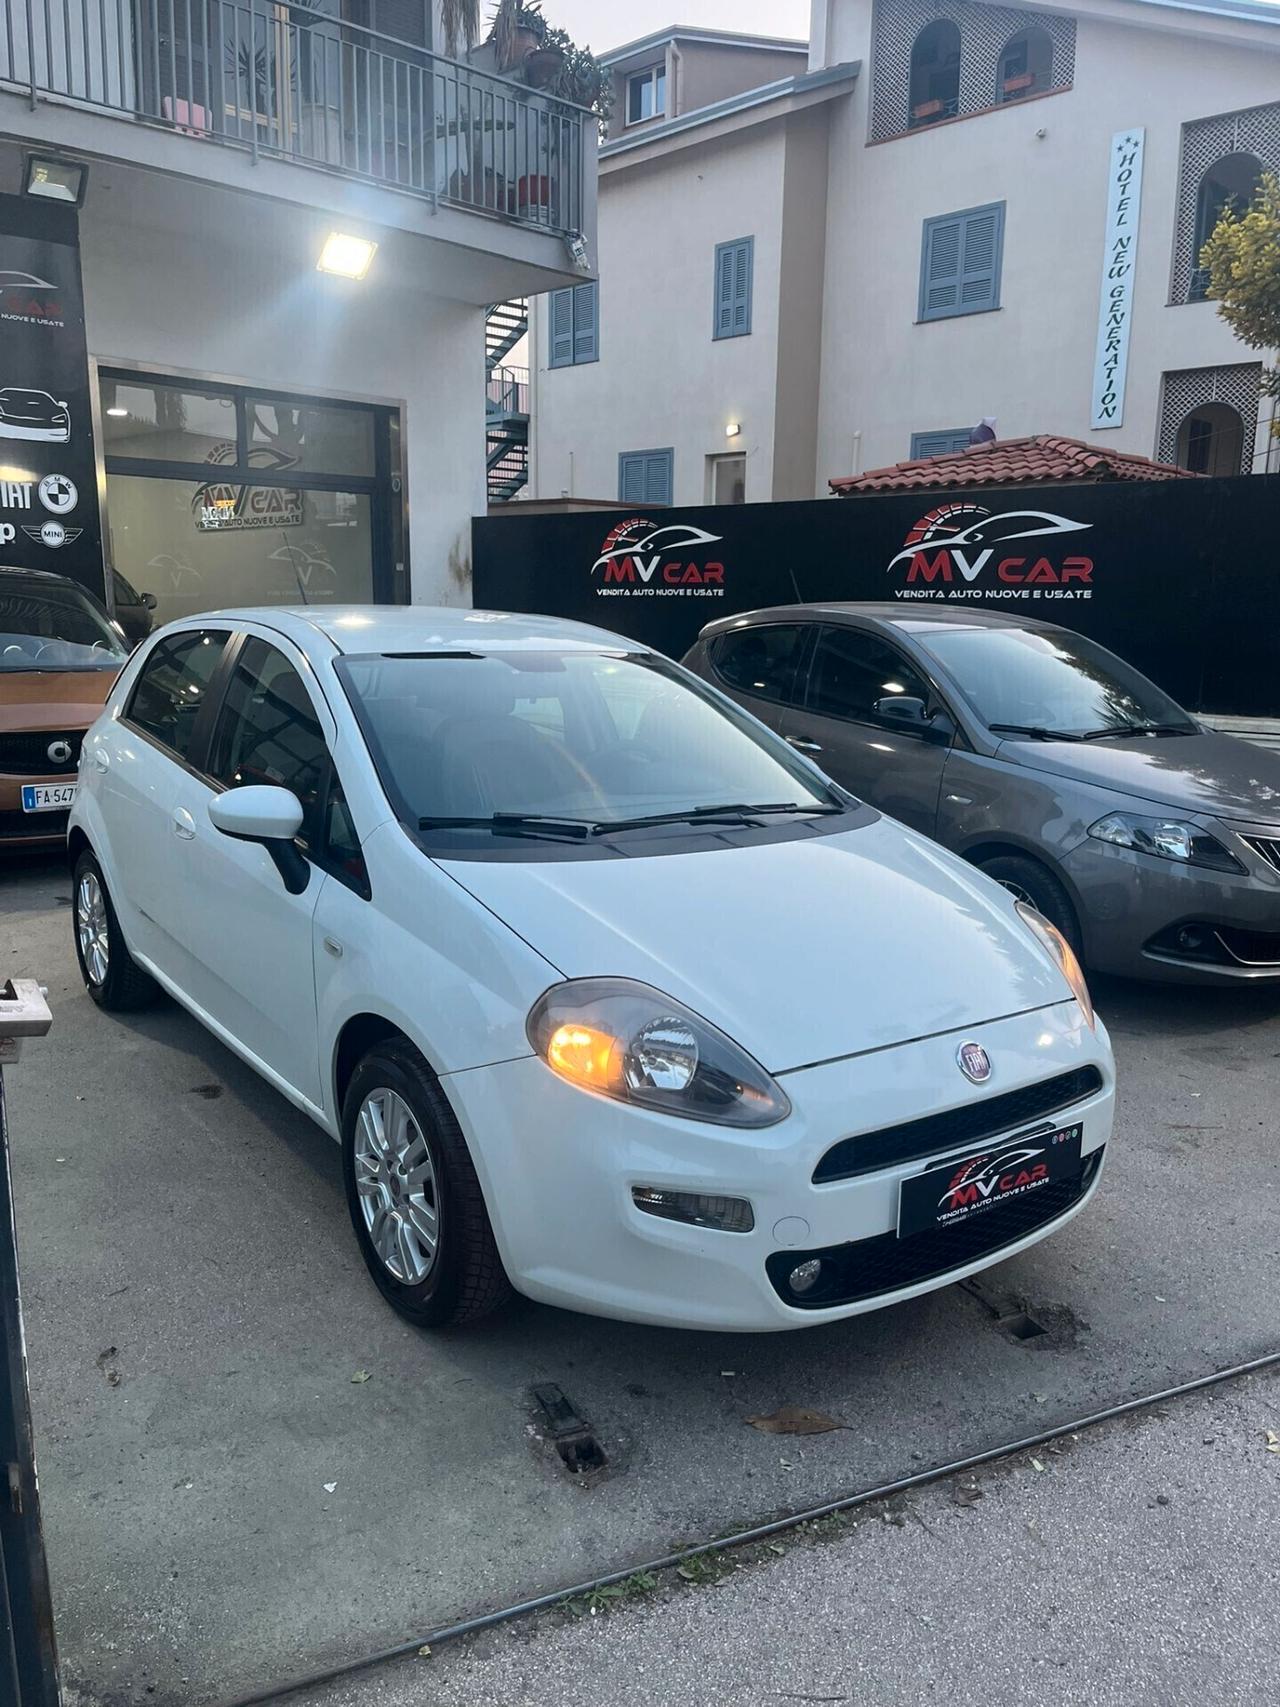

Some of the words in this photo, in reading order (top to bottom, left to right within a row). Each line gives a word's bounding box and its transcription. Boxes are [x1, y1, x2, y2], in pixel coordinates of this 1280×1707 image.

[1116, 151, 1137, 227] HOTEL
[1108, 235, 1132, 280] NEW
[1, 313, 29, 322] NUOVE
[37, 318, 65, 327] USATE
[1098, 285, 1126, 419] GENERATION
[0, 480, 33, 510] IAT
[251, 488, 301, 514] CAR
[243, 516, 268, 526] NUOVE
[275, 513, 300, 524] USATE
[43, 530, 63, 539] MINI
[603, 555, 661, 583] MV
[663, 562, 725, 583] CAR
[906, 548, 995, 583] MV
[997, 556, 1094, 583] CAR
[596, 588, 631, 597] VENDITA
[631, 588, 655, 597] AUTO
[656, 588, 685, 597] NUOVE
[686, 588, 692, 597] E
[693, 588, 724, 597] USATE
[894, 589, 946, 599] VENDITA
[948, 589, 983, 599] AUTO
[985, 589, 1030, 599] NUOVE
[1032, 589, 1041, 599] E
[1044, 589, 1093, 599] USATE
[36, 789, 50, 804] FA
[53, 787, 79, 803] 547
[965, 1053, 986, 1072] FIAT
[936, 1206, 969, 1222] VENDITA
[970, 1197, 993, 1211] AUTO
[993, 1187, 1019, 1202] NUOVE
[1020, 1183, 1026, 1192] E
[1026, 1176, 1050, 1190] USATE
[949, 1174, 1000, 1210] MV
[999, 1162, 1048, 1191] CAR
